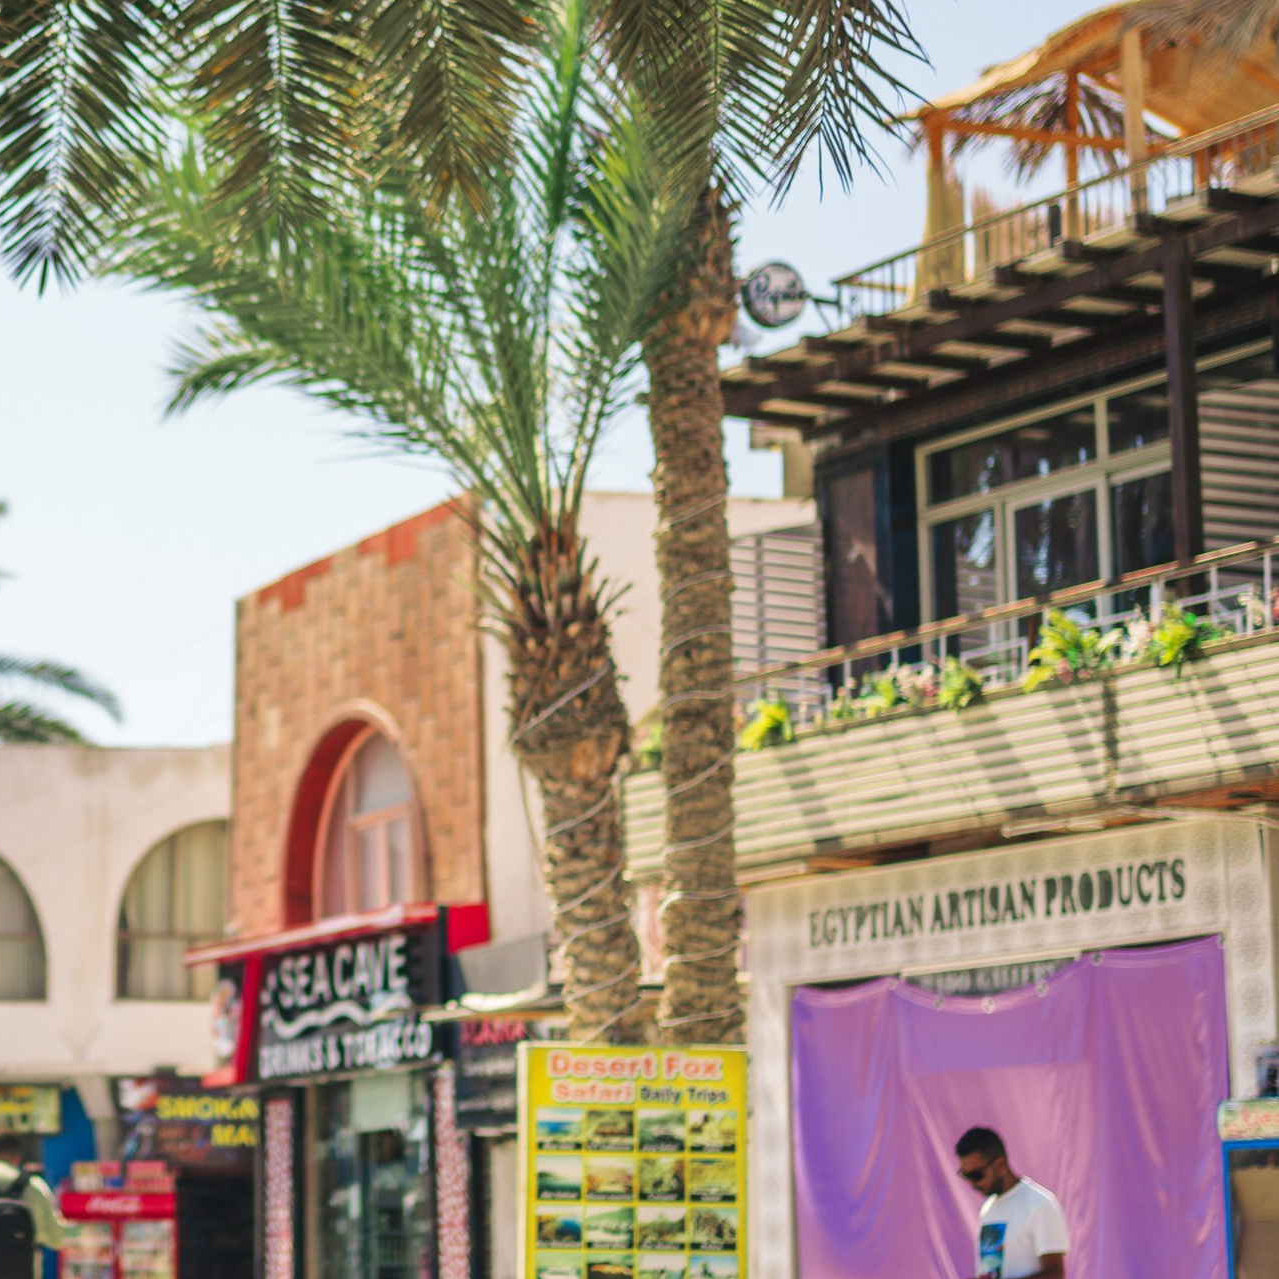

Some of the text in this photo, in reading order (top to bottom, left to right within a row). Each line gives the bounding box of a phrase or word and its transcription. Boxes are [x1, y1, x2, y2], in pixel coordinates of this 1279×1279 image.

[809, 858, 1186, 948] EGYPTIAN ARTISAN PRODUCTS
[278, 933, 409, 1008] SEA CAVE
[550, 1051, 722, 1079] Desert Fox
[553, 1082, 729, 1105] Safari Daily Trips
